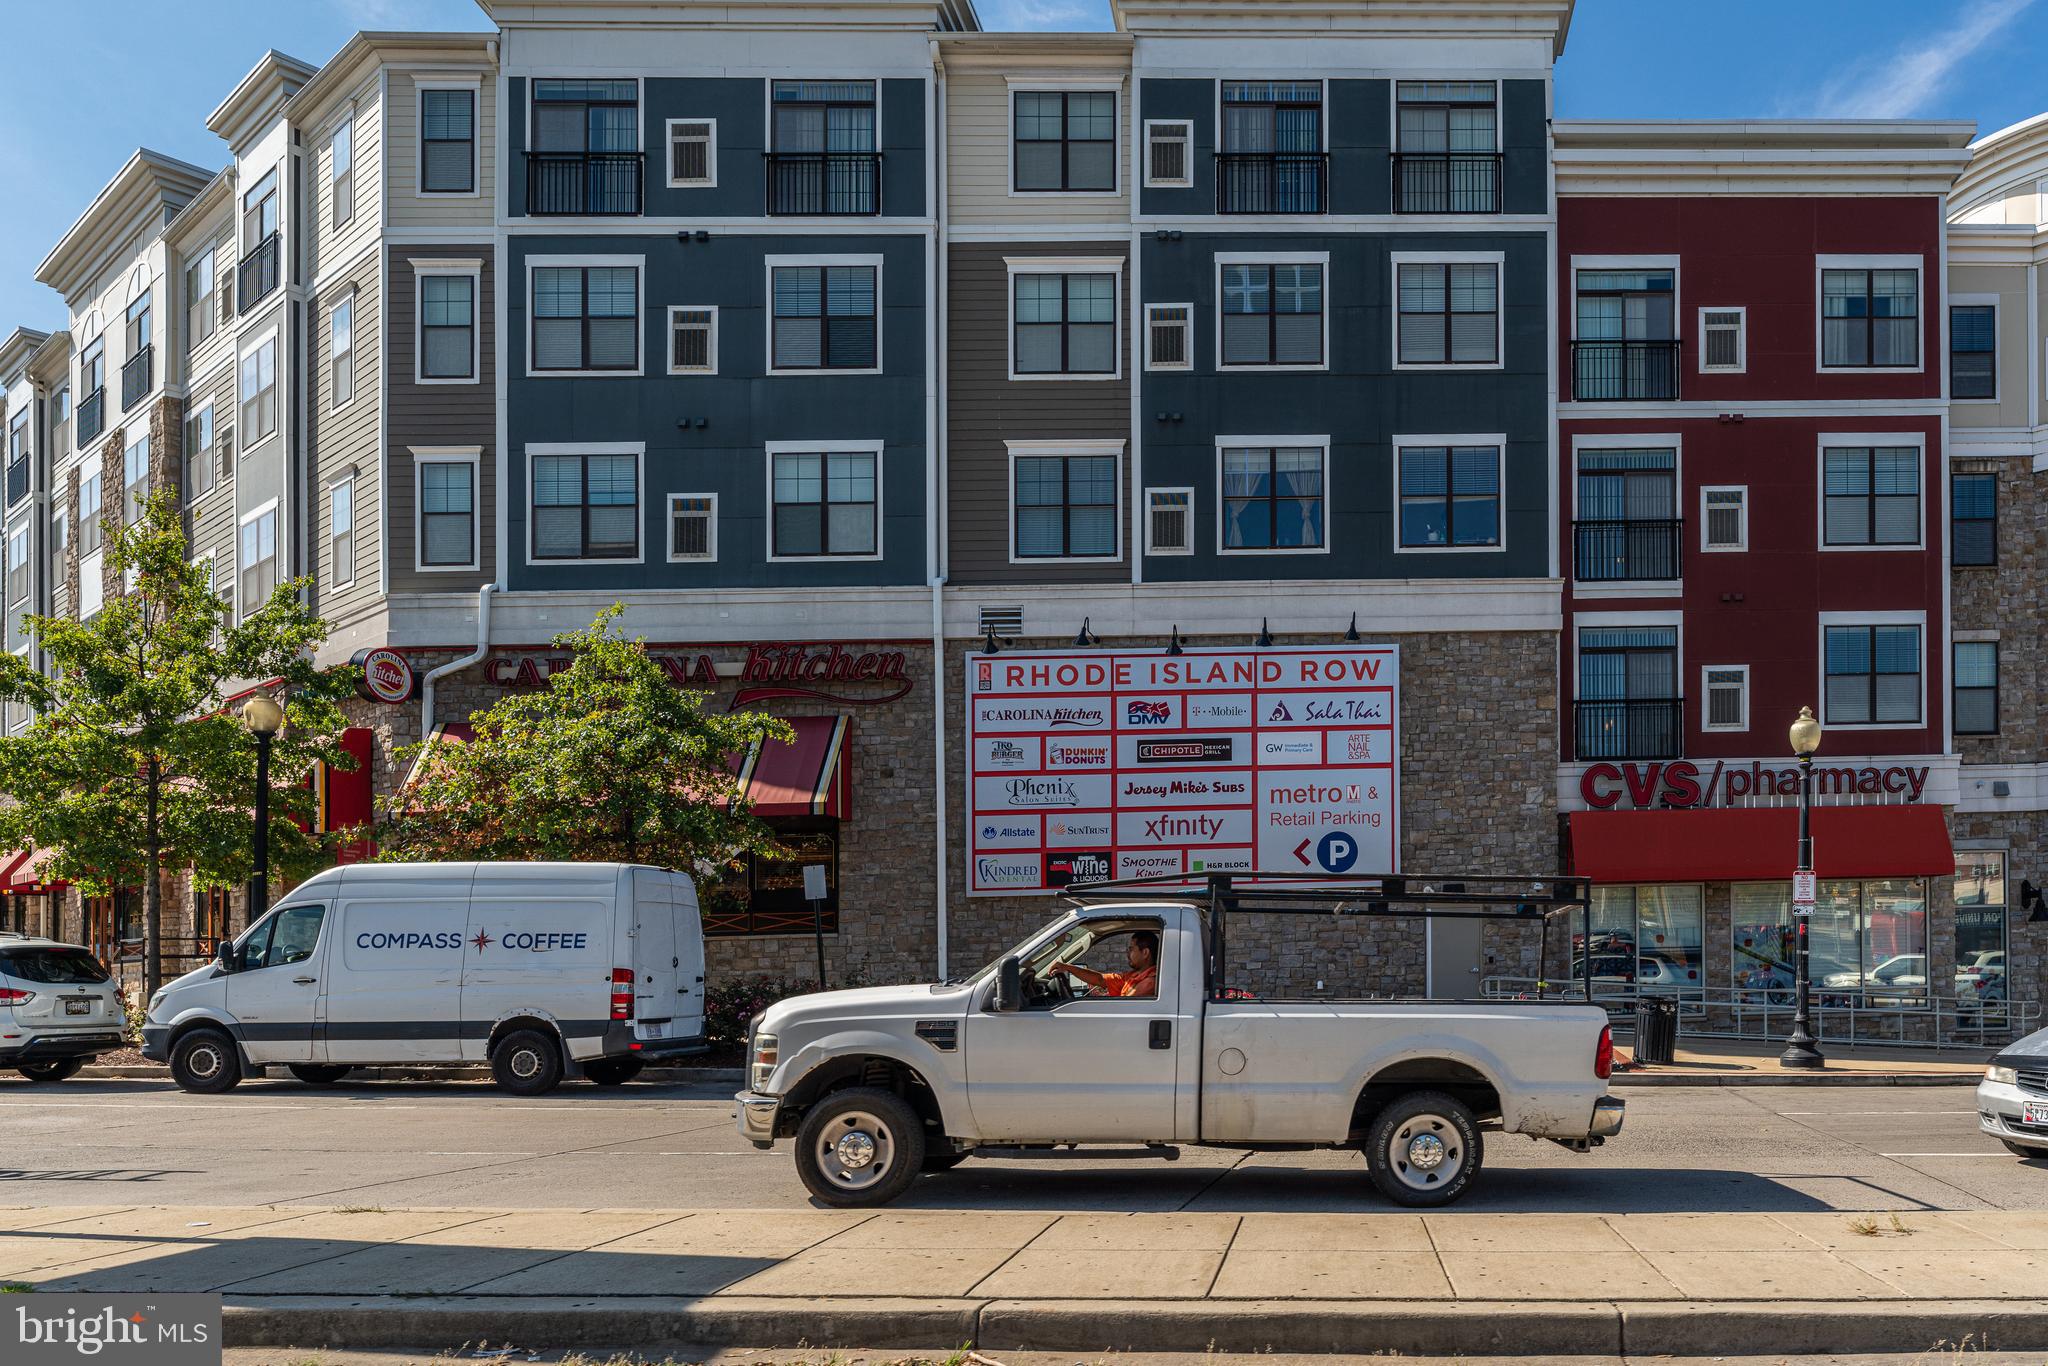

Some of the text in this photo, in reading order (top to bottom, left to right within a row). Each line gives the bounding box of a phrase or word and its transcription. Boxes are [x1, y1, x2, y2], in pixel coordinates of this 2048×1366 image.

[371, 652, 406, 671] CAROLINA
[484, 642, 912, 687] CARNA Kitchen
[1006, 663, 1131, 687] RHODE
[1151, 661, 1281, 684] ISLAND
[1300, 659, 1381, 681] ROW
[986, 709, 1053, 721] CAROLINA
[1053, 708, 1103, 721] Kitchen
[1305, 700, 1382, 721] Sala Thai
[1128, 714, 1168, 725] DMV
[1347, 734, 1371, 743] ARTE
[1065, 748, 1108, 756] DUNKIN'
[1154, 746, 1201, 755] CHIPOTLE
[1265, 743, 1283, 753] GW
[1347, 743, 1371, 751] NAIL
[991, 751, 1024, 760] BURGER
[1065, 756, 1106, 765] DONUTS
[1347, 751, 1371, 760] &SPA
[1005, 778, 1078, 797] Phenix
[1124, 782, 1168, 798] Jersey
[1169, 781, 1209, 794] Mike's
[1270, 784, 1343, 804] metro
[1367, 785, 1378, 799] &
[1270, 810, 1381, 828] Retail Parking
[1000, 828, 1036, 837] Allstate
[1145, 814, 1224, 841] xfinity
[1329, 840, 1350, 866] P
[1072, 860, 1109, 875] wine
[1121, 857, 1178, 867] SMOOTHIE
[985, 864, 1038, 880] KINDRED
[356, 932, 587, 949] COMPASS COFFEE
